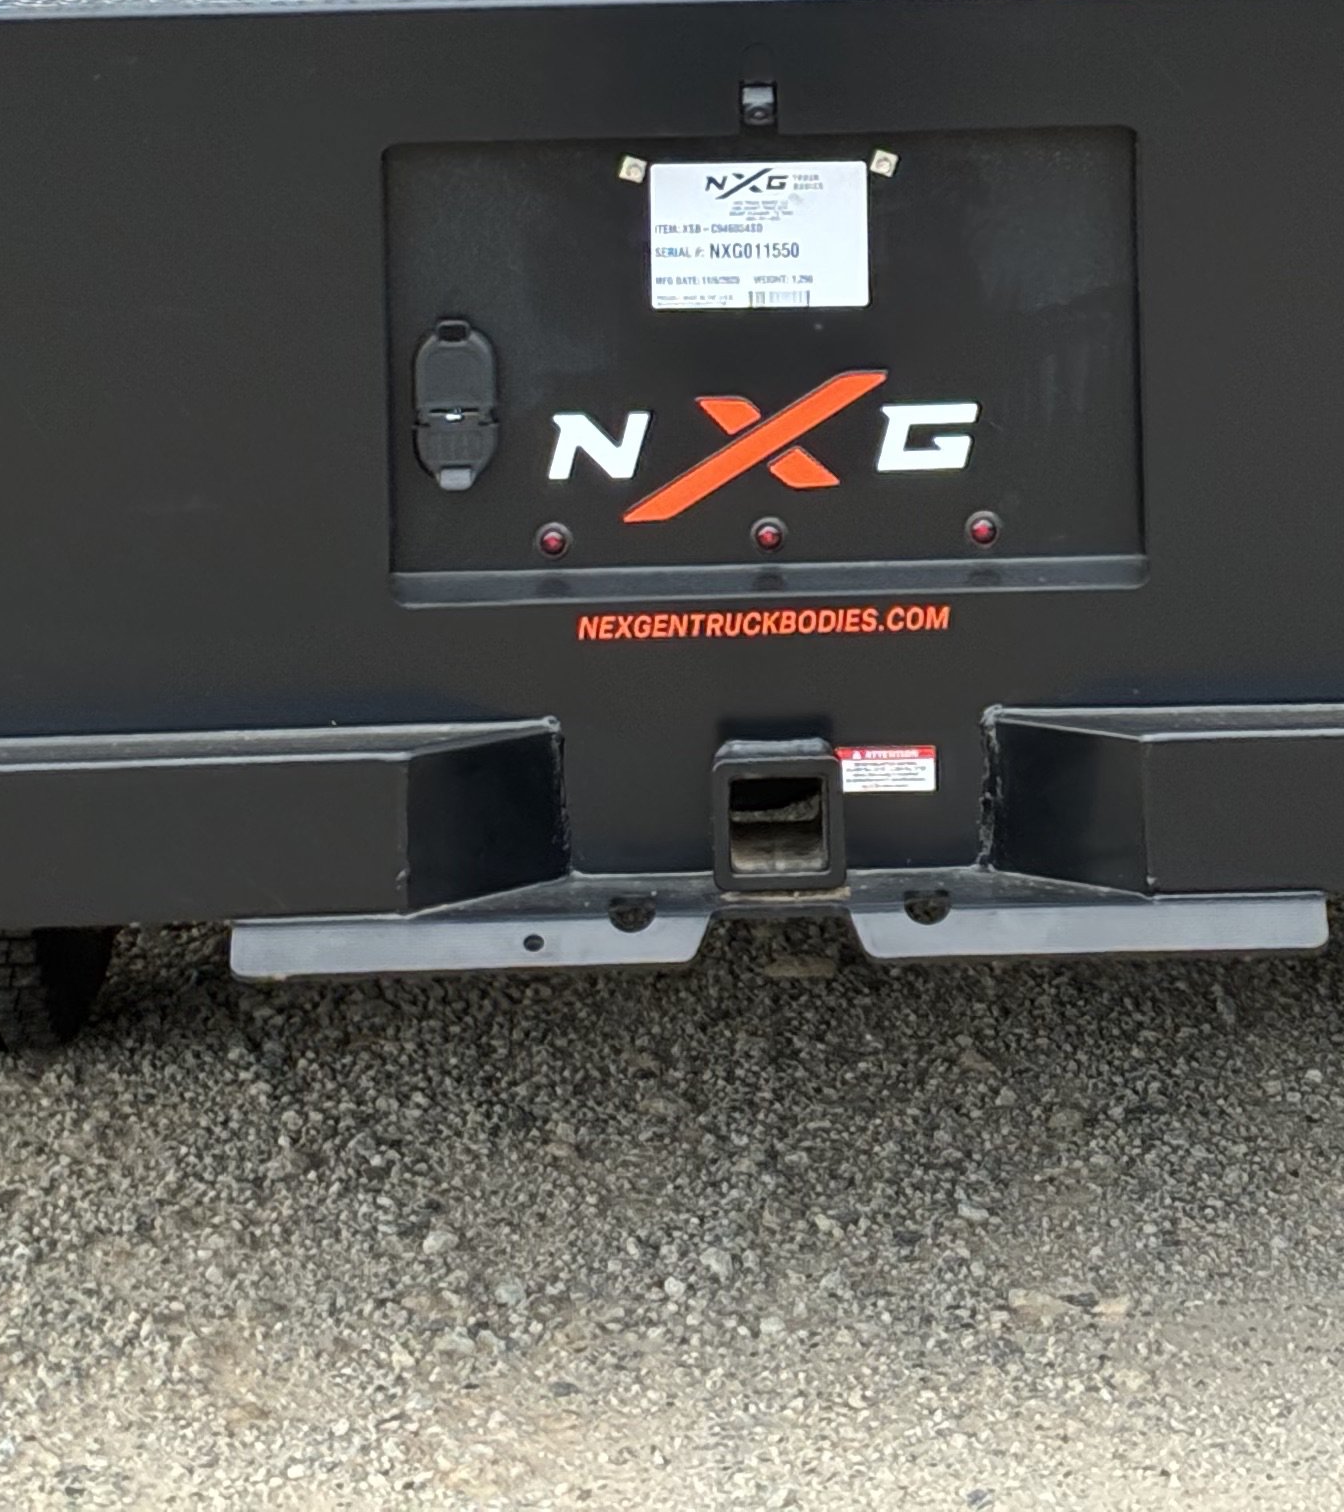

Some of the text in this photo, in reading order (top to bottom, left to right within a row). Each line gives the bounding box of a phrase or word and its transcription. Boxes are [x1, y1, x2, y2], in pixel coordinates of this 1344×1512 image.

[655, 246, 692, 258] SERIAL
[709, 242, 800, 259] NXG011550
[547, 369, 981, 523] NXG
[577, 605, 952, 641] NEXGENTRUCKBODIES.COM
